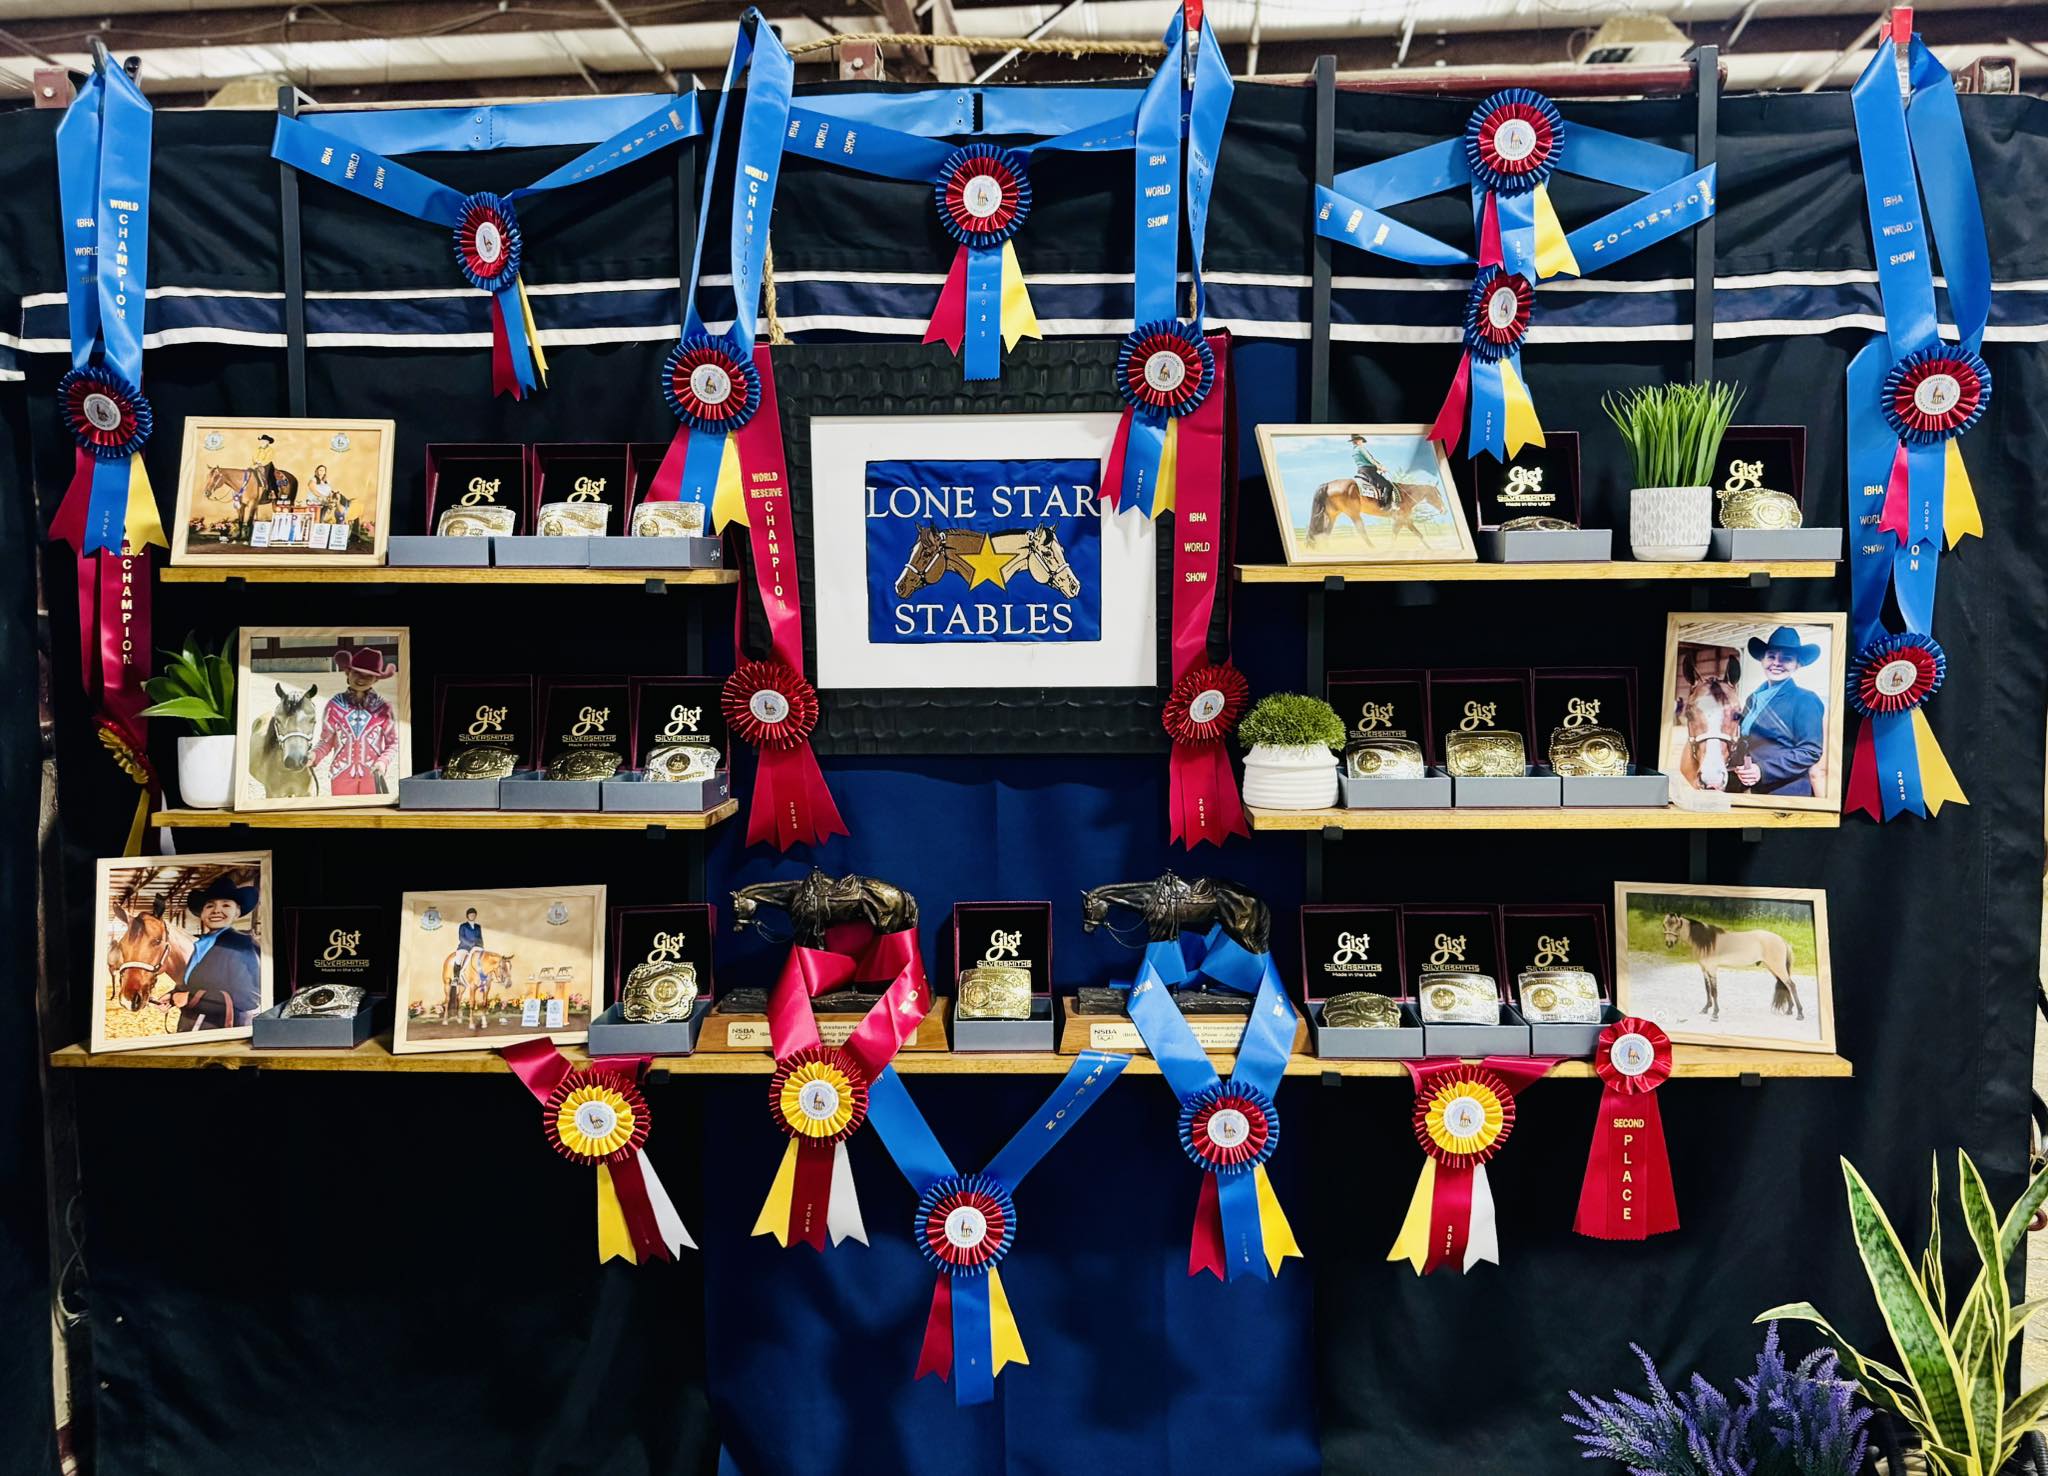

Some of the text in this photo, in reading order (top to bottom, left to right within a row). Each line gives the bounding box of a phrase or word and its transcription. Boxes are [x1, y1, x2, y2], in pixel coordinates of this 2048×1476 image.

[788, 120, 801, 138] IBHA
[814, 122, 830, 149] WORLD
[843, 130, 858, 154] SHOW
[344, 153, 360, 180] WORLD
[1149, 154, 1167, 166] IBHA
[373, 166, 386, 190] SHOW
[1144, 184, 1171, 198] WORLD
[109, 199, 140, 212] WORLD
[1882, 194, 1904, 208] IBHA
[76, 218, 95, 228] IBHA
[1147, 214, 1169, 228] SHOW
[1882, 222, 1914, 237] WORLD
[115, 213, 129, 320] CHAMPION
[1889, 250, 1916, 266] SHOW
[752, 472, 779, 482] WORLD
[1504, 465, 1544, 495] Gist
[1725, 459, 1764, 491] Gist
[461, 477, 501, 506] Gist
[567, 477, 607, 503] Gist
[751, 488, 783, 499] RESERVE
[866, 485, 1101, 518] LONE STAR
[1864, 485, 1884, 496] IBHA
[1189, 513, 1207, 522] IBHA
[1860, 512, 1882, 525] WORL
[765, 501, 786, 610] CHAMPION
[1183, 542, 1210, 552] WORLD
[1185, 572, 1207, 582] SHOW
[120, 559, 133, 665] CHAMPION
[895, 603, 1073, 635] STABLES
[468, 705, 508, 735] Gist
[571, 706, 611, 736] Gist
[664, 704, 702, 736] Gist
[1358, 702, 1394, 731] Gist
[1460, 701, 1497, 731] Gist
[1563, 698, 1601, 728] Gist
[323, 929, 361, 960] Gist
[648, 932, 685, 963] Gist
[985, 930, 1022, 961] Gist
[1333, 932, 1370, 964] Gist
[1430, 934, 1466, 965] Gist
[1534, 936, 1570, 967] Gist
[1613, 1118, 1645, 1128] SECOND
[1622, 1135, 1633, 1220] PLACE
